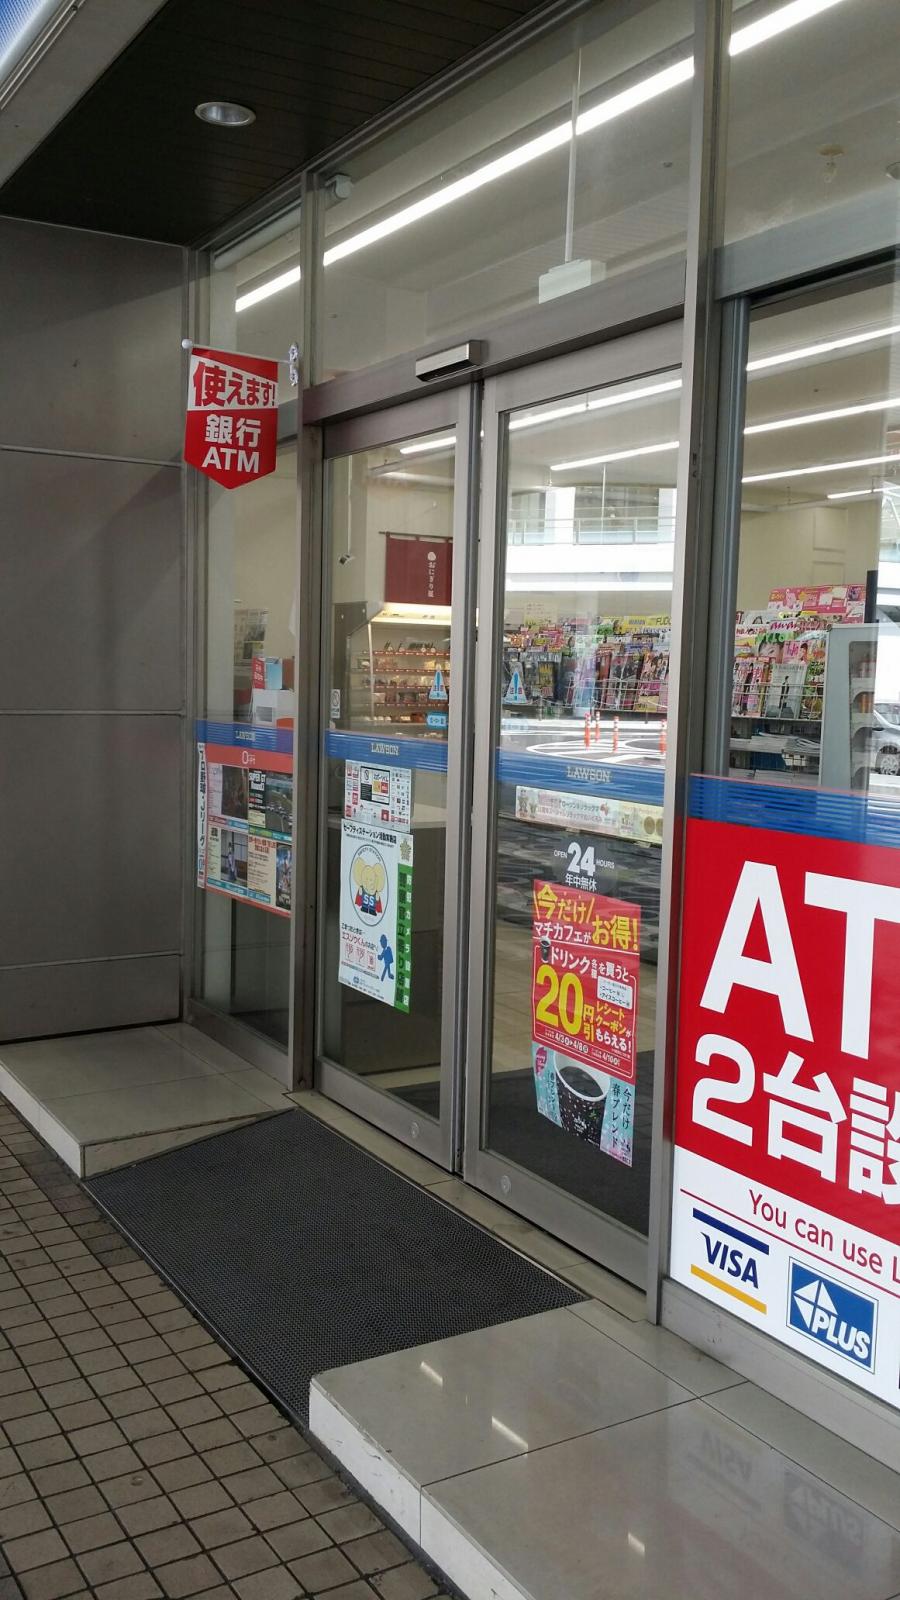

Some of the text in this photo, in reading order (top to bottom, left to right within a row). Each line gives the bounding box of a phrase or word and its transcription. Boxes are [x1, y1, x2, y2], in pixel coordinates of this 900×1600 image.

[193, 361, 276, 407] 使えます!
[205, 414, 261, 448] 銀行
[201, 446, 260, 474] ATM
[371, 743, 399, 756] LAWSON
[567, 766, 613, 784] LAWSON
[554, 842, 615, 876] OPEN 24 HOURS
[565, 873, 597, 891] 年中無休
[363, 894, 375, 908] SS
[592, 915, 638, 950] お得!
[749, 1189, 786, 1229] You
[795, 1217, 833, 1251] can
[843, 1238, 883, 1275] use
[701, 1231, 760, 1289] VISA
[811, 1309, 871, 1360] PLUS
